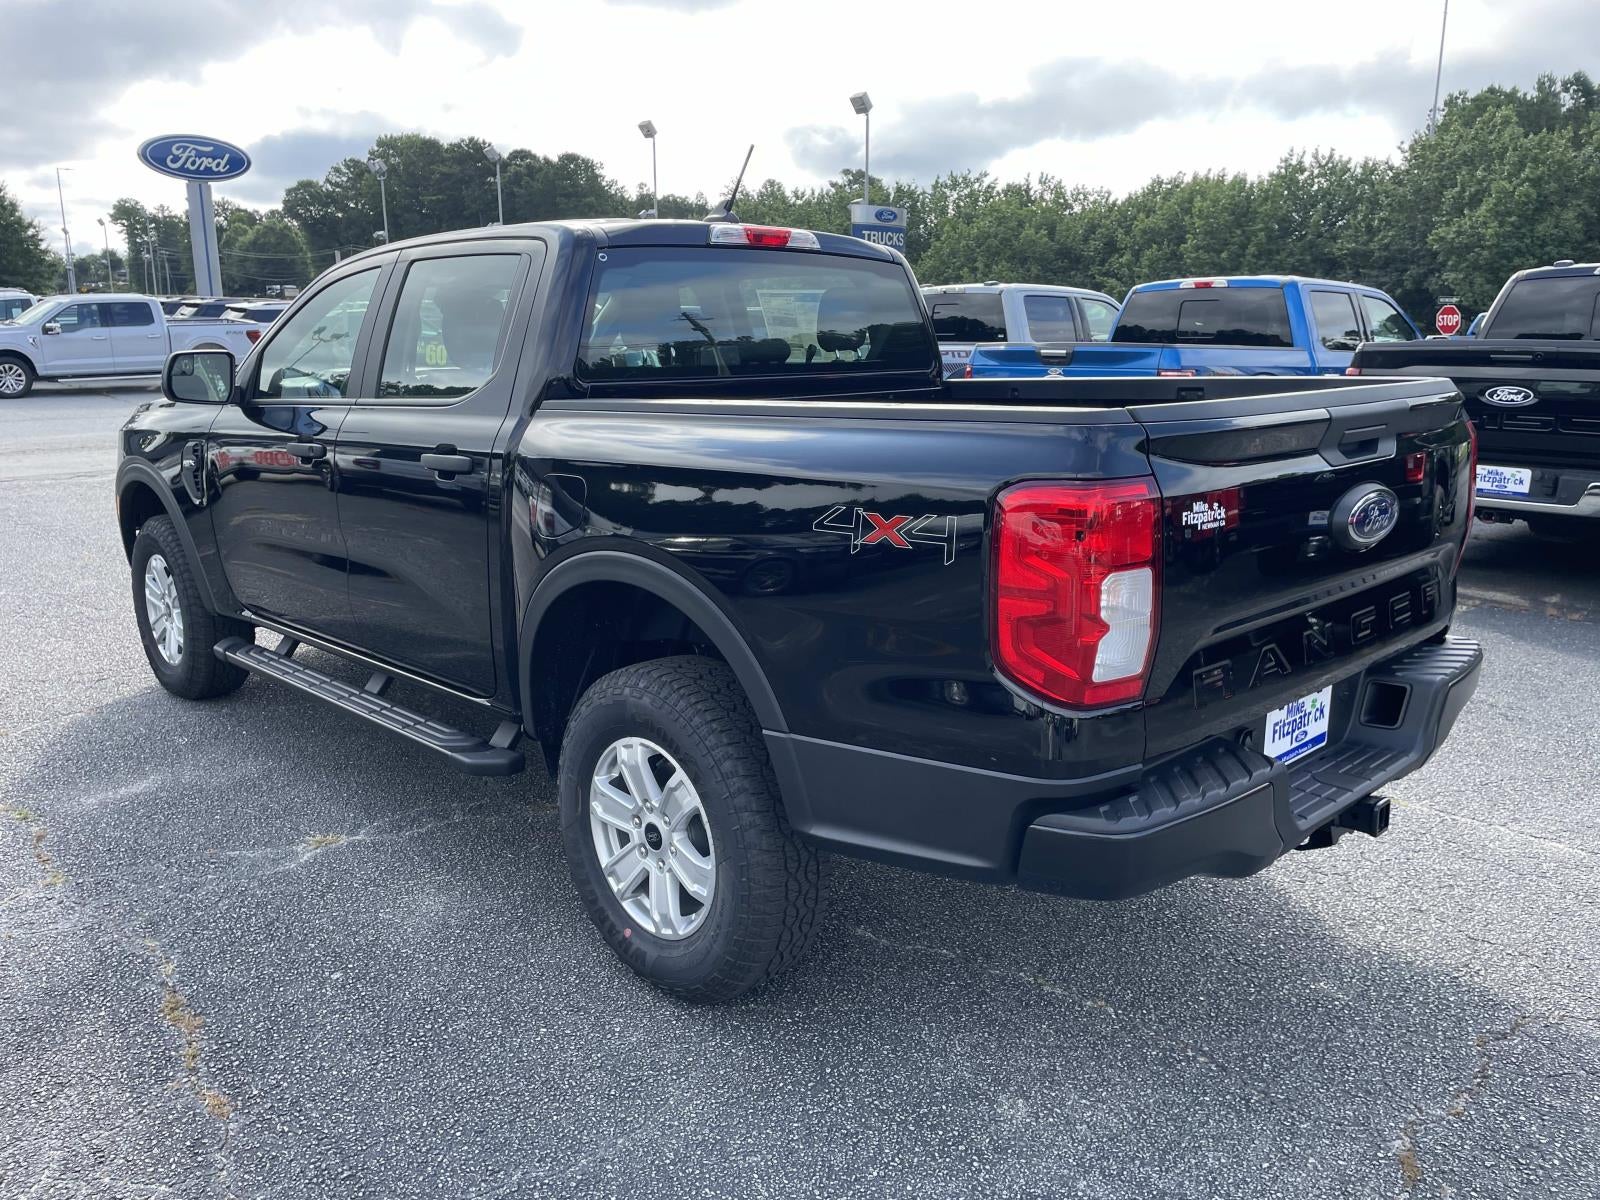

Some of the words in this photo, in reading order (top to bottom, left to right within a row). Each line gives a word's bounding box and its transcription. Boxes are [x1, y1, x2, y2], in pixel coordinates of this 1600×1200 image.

[166, 143, 230, 172] Ford
[862, 230, 904, 246] TRUCKS
[1438, 314, 1459, 326] STOP
[1493, 388, 1525, 401] Ford
[1487, 469, 1504, 477] Mike
[1193, 501, 1209, 513] Mike
[1182, 506, 1226, 531] Fitzpatrick
[1364, 502, 1390, 533] Ford
[1192, 581, 1441, 711] RANGER
[1286, 700, 1306, 720] Mike
[1271, 701, 1326, 747] Fitzpatrick
